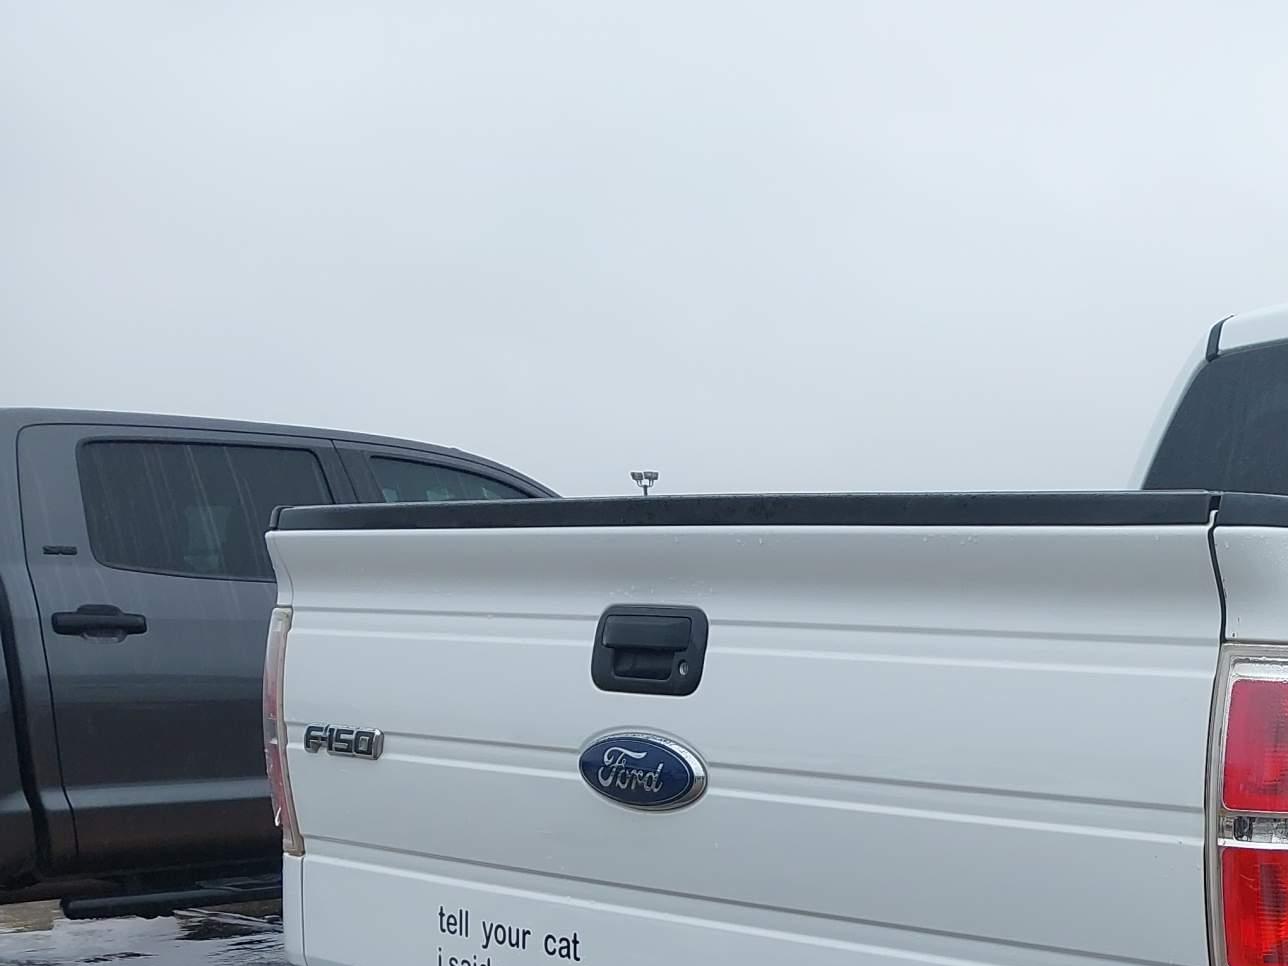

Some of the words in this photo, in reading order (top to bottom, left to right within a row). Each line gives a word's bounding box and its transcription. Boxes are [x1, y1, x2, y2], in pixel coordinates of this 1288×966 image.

[304, 724, 382, 760] F-150
[598, 746, 664, 792] Ford
[438, 906, 469, 937] tell
[482, 921, 531, 949] your
[544, 933, 580, 961] cat
